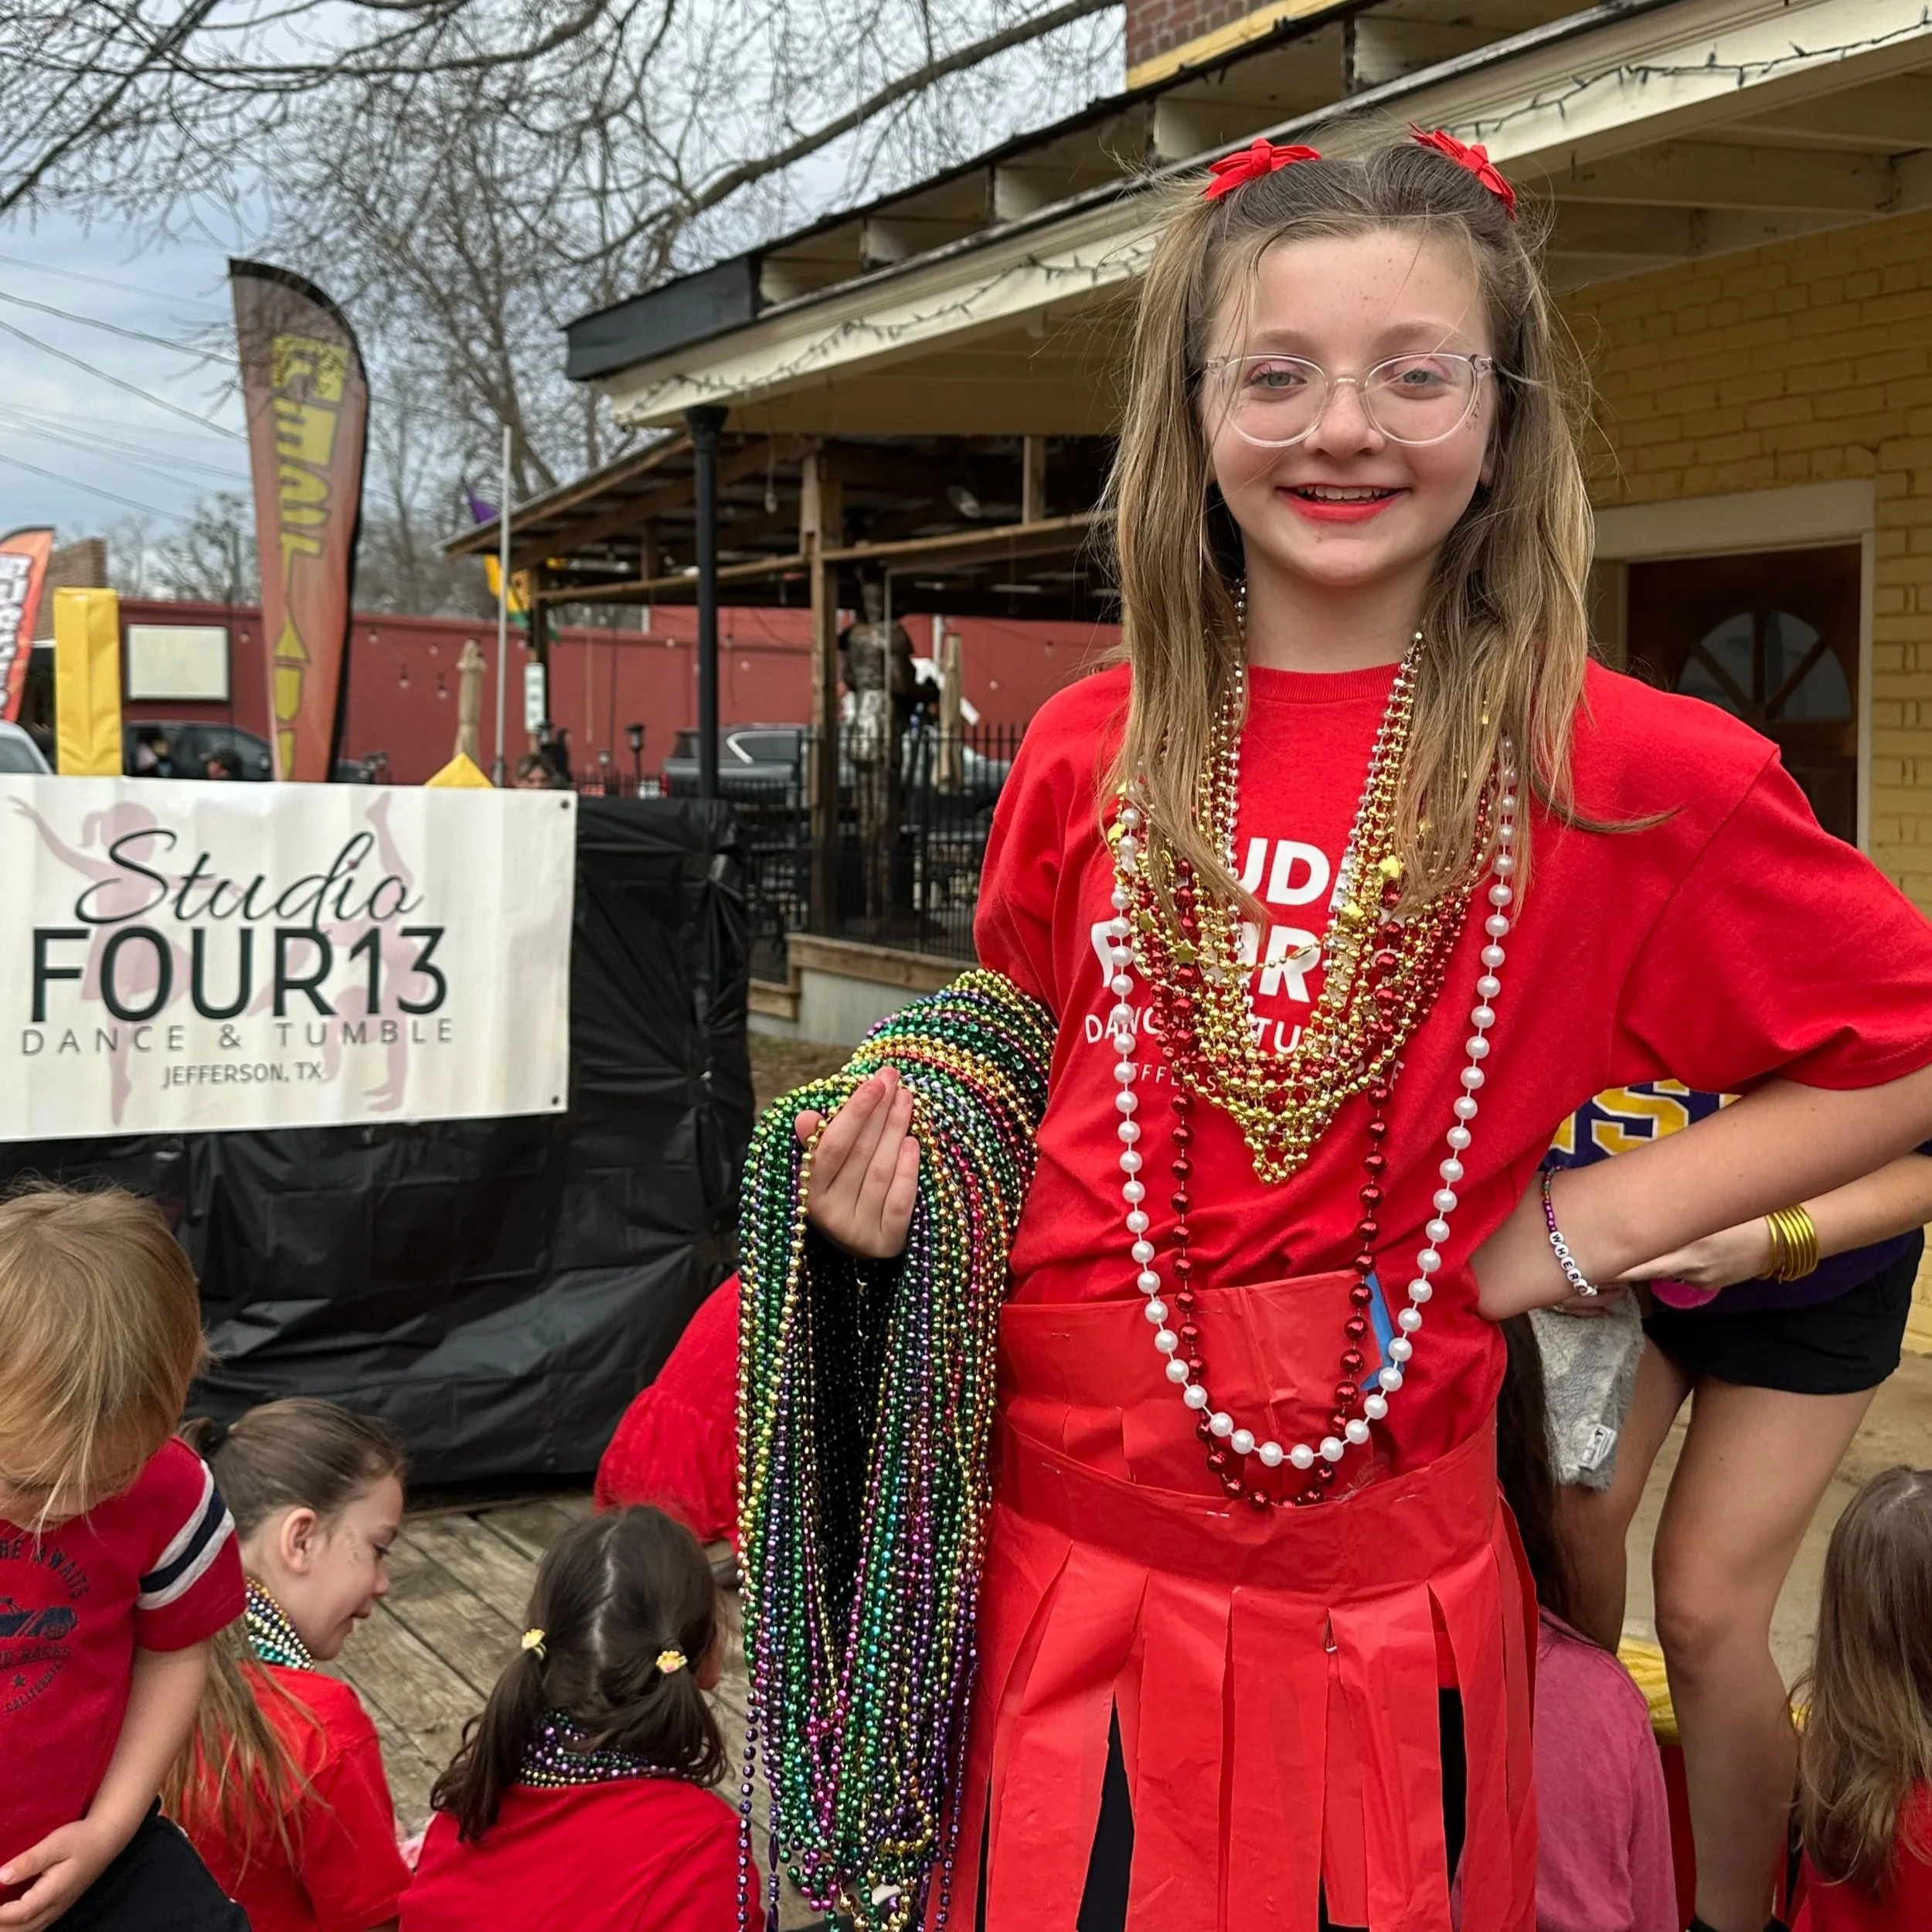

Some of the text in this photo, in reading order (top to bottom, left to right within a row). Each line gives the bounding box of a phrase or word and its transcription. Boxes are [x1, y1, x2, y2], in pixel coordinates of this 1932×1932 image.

[75, 828, 424, 929] Studio
[32, 927, 447, 1022] FOUR13
[22, 1019, 454, 1056] DANCE & TUMBLE
[161, 1062, 322, 1090] JEFFERSON, TX
